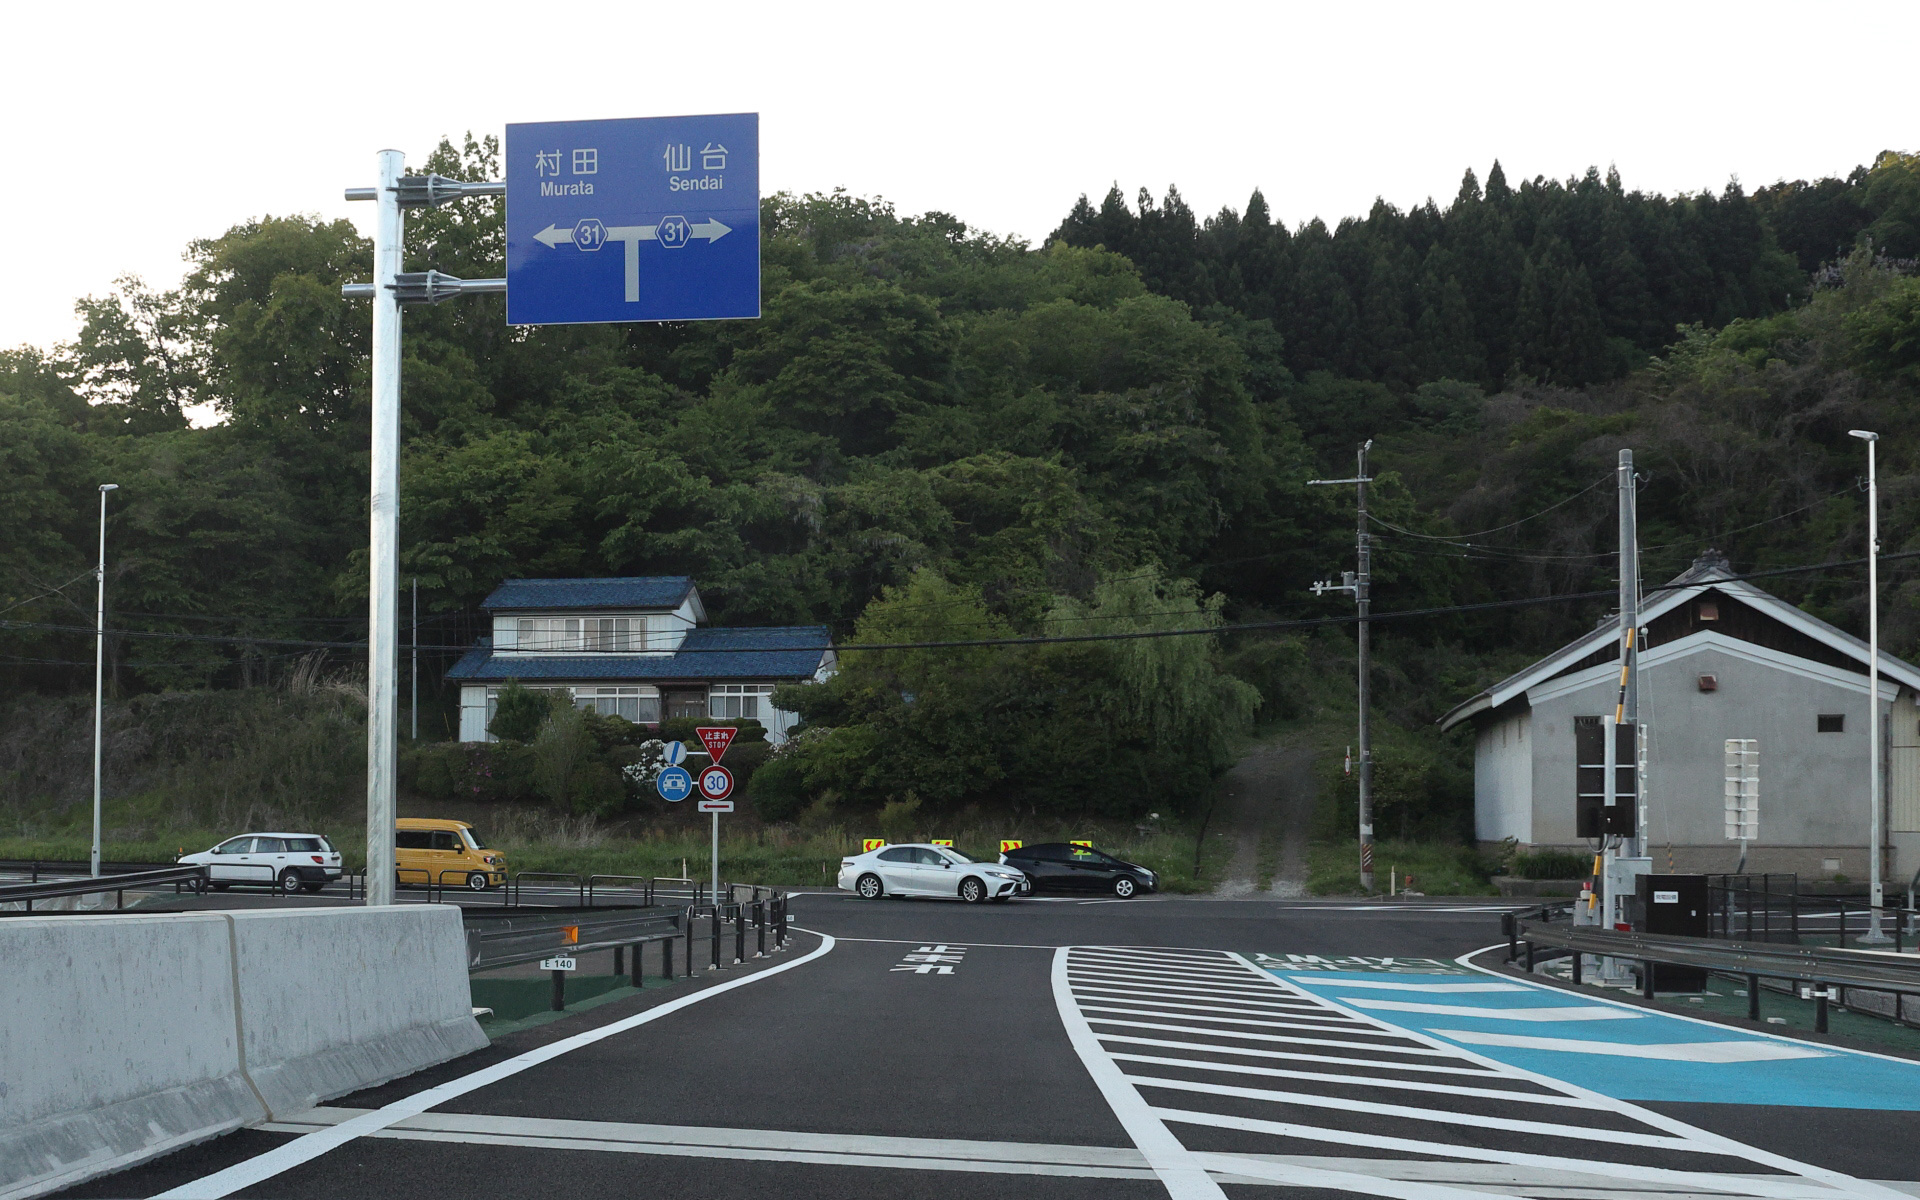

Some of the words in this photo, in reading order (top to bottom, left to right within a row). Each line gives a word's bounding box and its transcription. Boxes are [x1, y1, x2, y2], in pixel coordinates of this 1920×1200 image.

[535, 148, 598, 177] 村田
[663, 142, 728, 172] 仙台
[540, 181, 594, 197] Murata
[669, 175, 723, 192] Sendai
[580, 225, 599, 245] 31
[664, 222, 684, 242] 31
[705, 731, 729, 740] 止まれ
[707, 775, 726, 790] 30
[545, 959, 550, 968] E
[555, 960, 572, 968] 140
[889, 945, 967, 974] 止まれ
